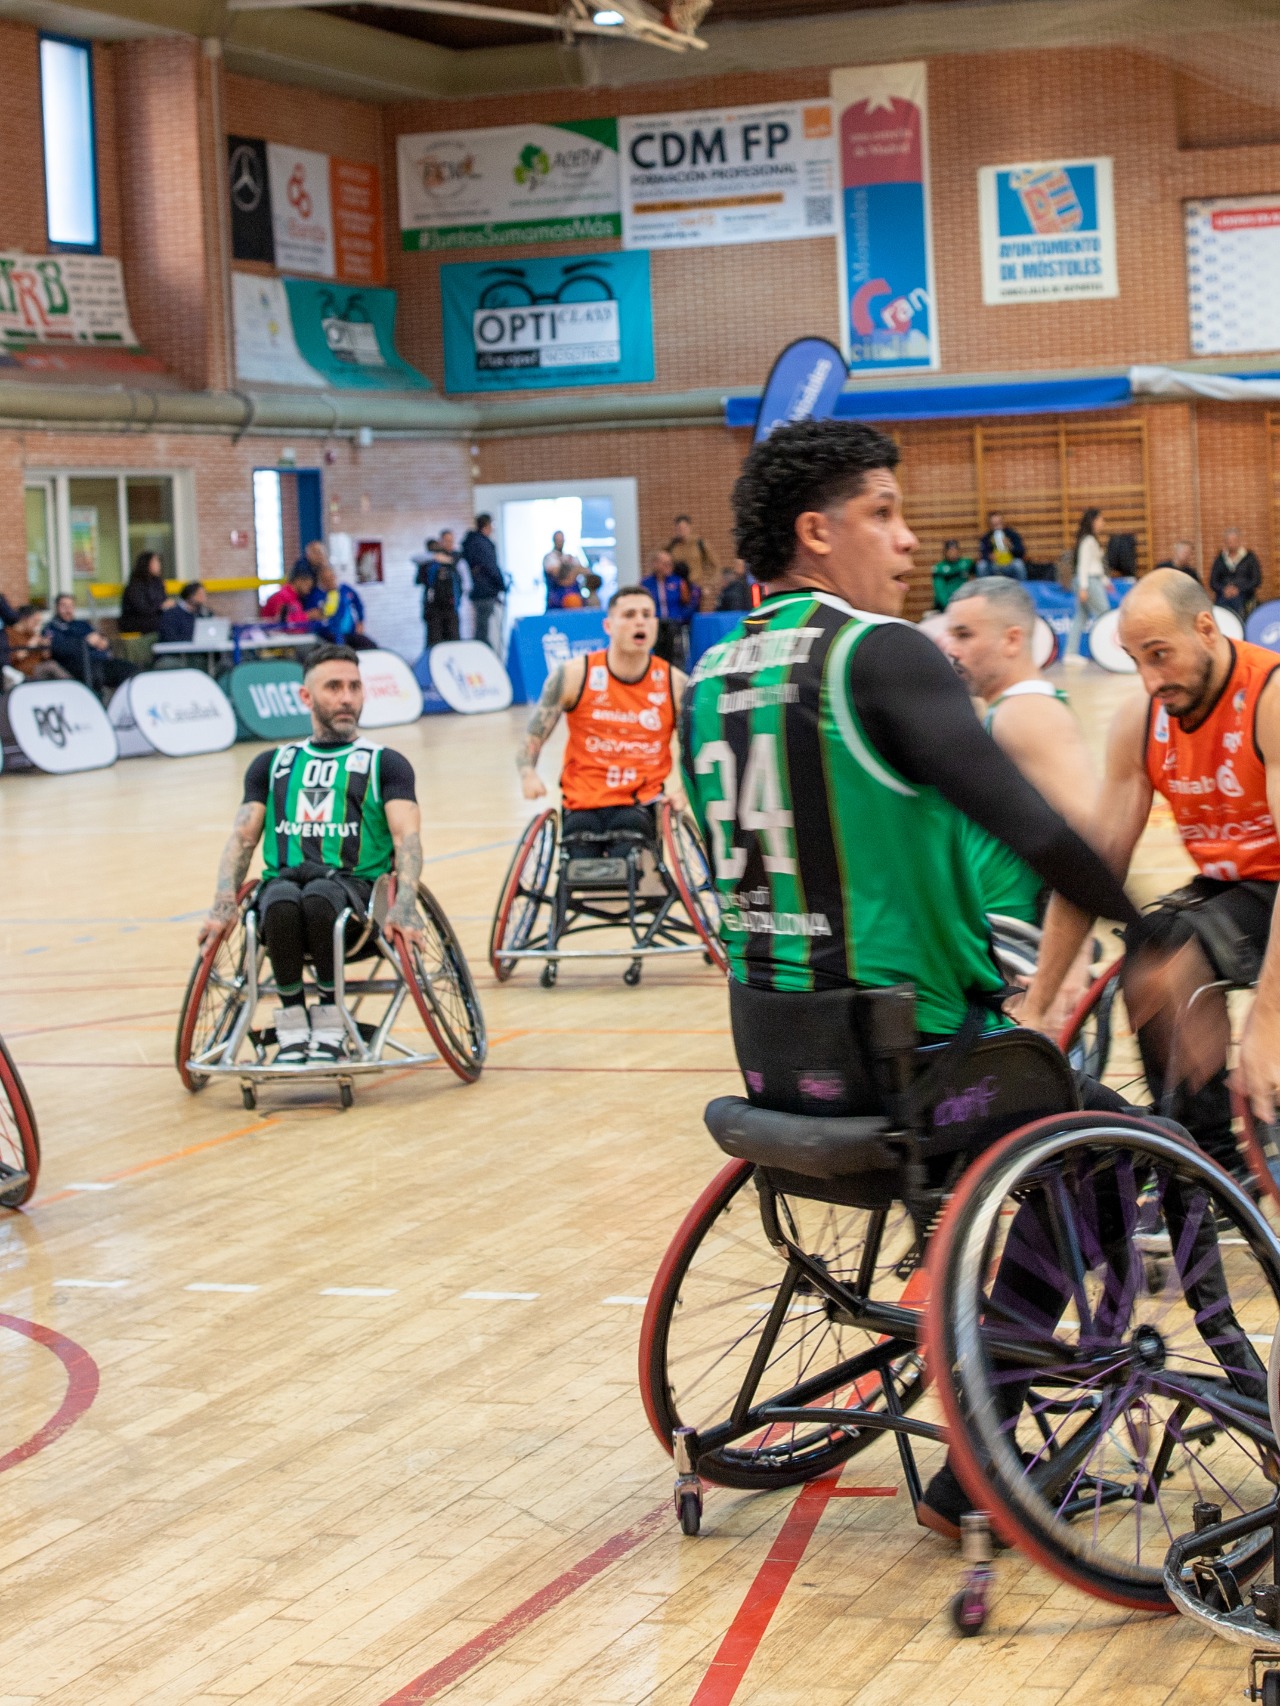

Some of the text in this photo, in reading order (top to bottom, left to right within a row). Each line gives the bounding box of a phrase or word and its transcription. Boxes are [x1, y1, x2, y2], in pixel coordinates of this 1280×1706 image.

[630, 127, 727, 169] CDM
[741, 121, 790, 161] FP
[711, 163, 798, 181] PROFESIONAL
[1000, 237, 1101, 258] AYUNTAMIENTO
[1023, 256, 1102, 279] MÓSTOLES
[479, 313, 556, 345] OPTI
[302, 758, 339, 788] 00
[694, 733, 799, 880] 24
